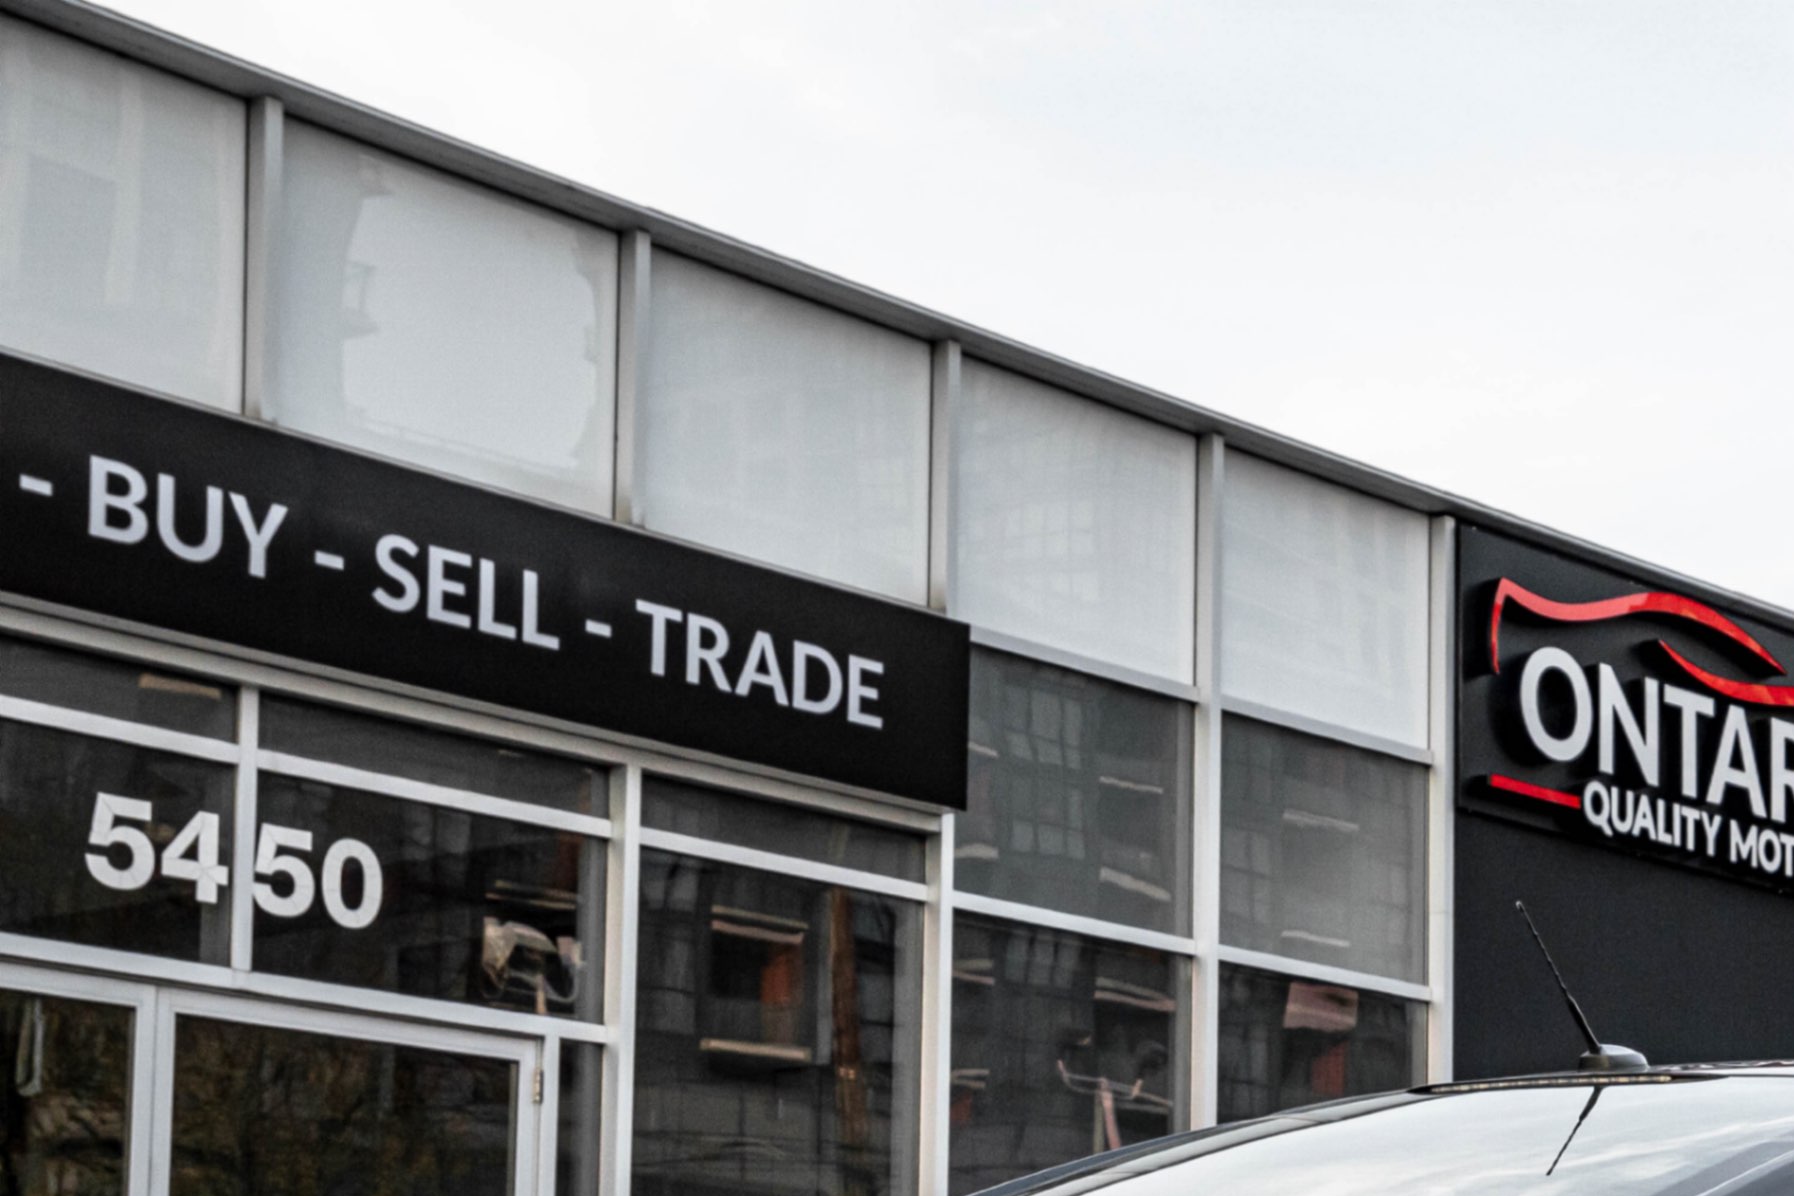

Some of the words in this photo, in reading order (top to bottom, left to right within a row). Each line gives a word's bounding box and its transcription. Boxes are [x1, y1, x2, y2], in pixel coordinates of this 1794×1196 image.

[87, 455, 288, 579] BUY
[371, 533, 561, 651] SELL
[636, 598, 885, 729] TRADE
[85, 792, 383, 931] 5450
[1583, 780, 1722, 857] QUALITY
